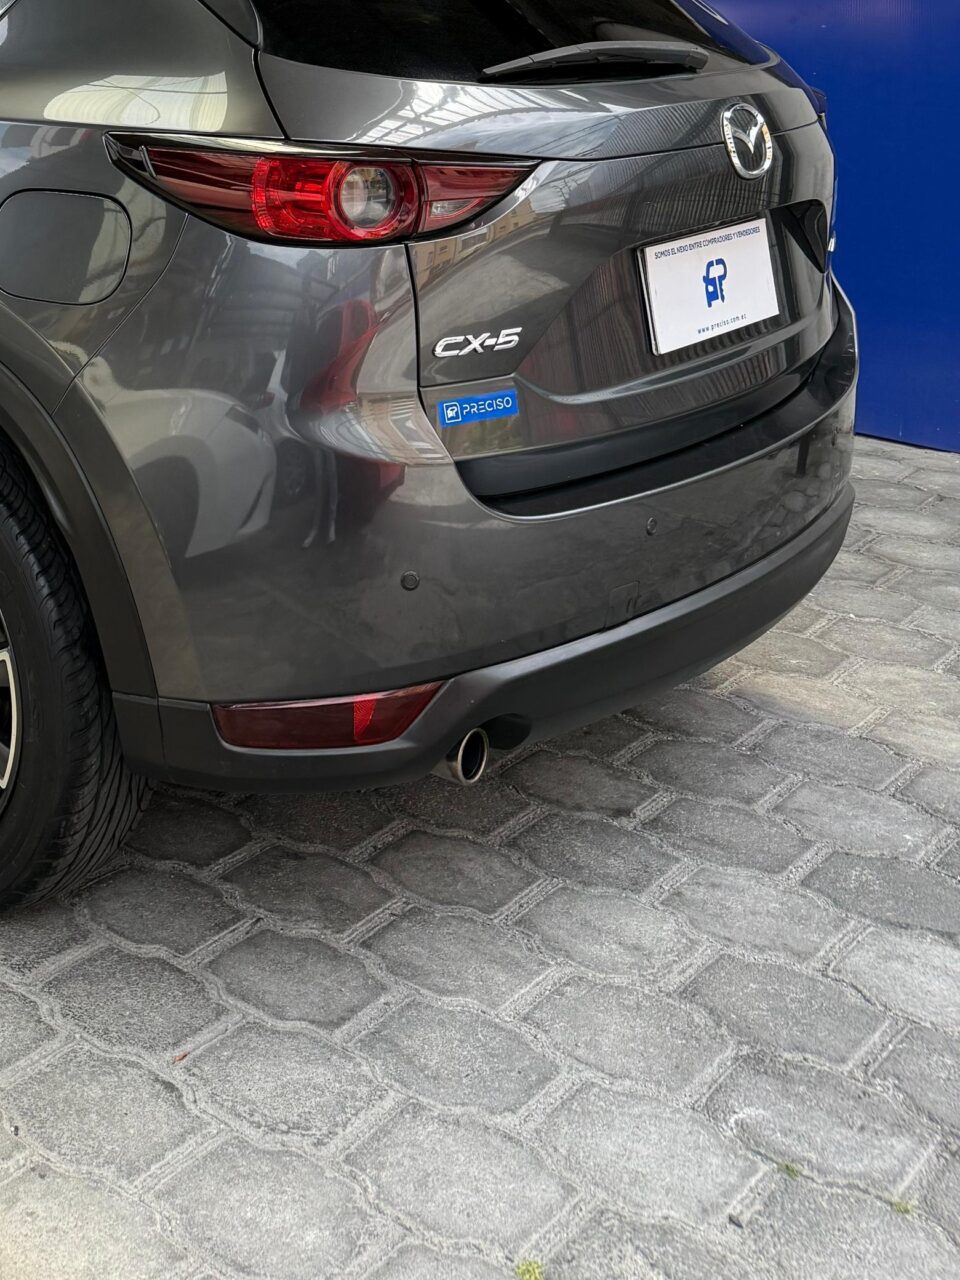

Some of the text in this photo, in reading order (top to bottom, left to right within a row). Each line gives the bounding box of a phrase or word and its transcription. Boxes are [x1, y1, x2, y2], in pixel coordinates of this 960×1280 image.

[654, 249, 671, 260] SOMOS
[676, 244, 689, 256] NEXO
[689, 240, 703, 252] ENTRE
[703, 232, 733, 247] COMPRADORES
[735, 225, 761, 239] VENDEDORES
[434, 326, 523, 358] CX-5
[463, 396, 512, 416] PRECISO
